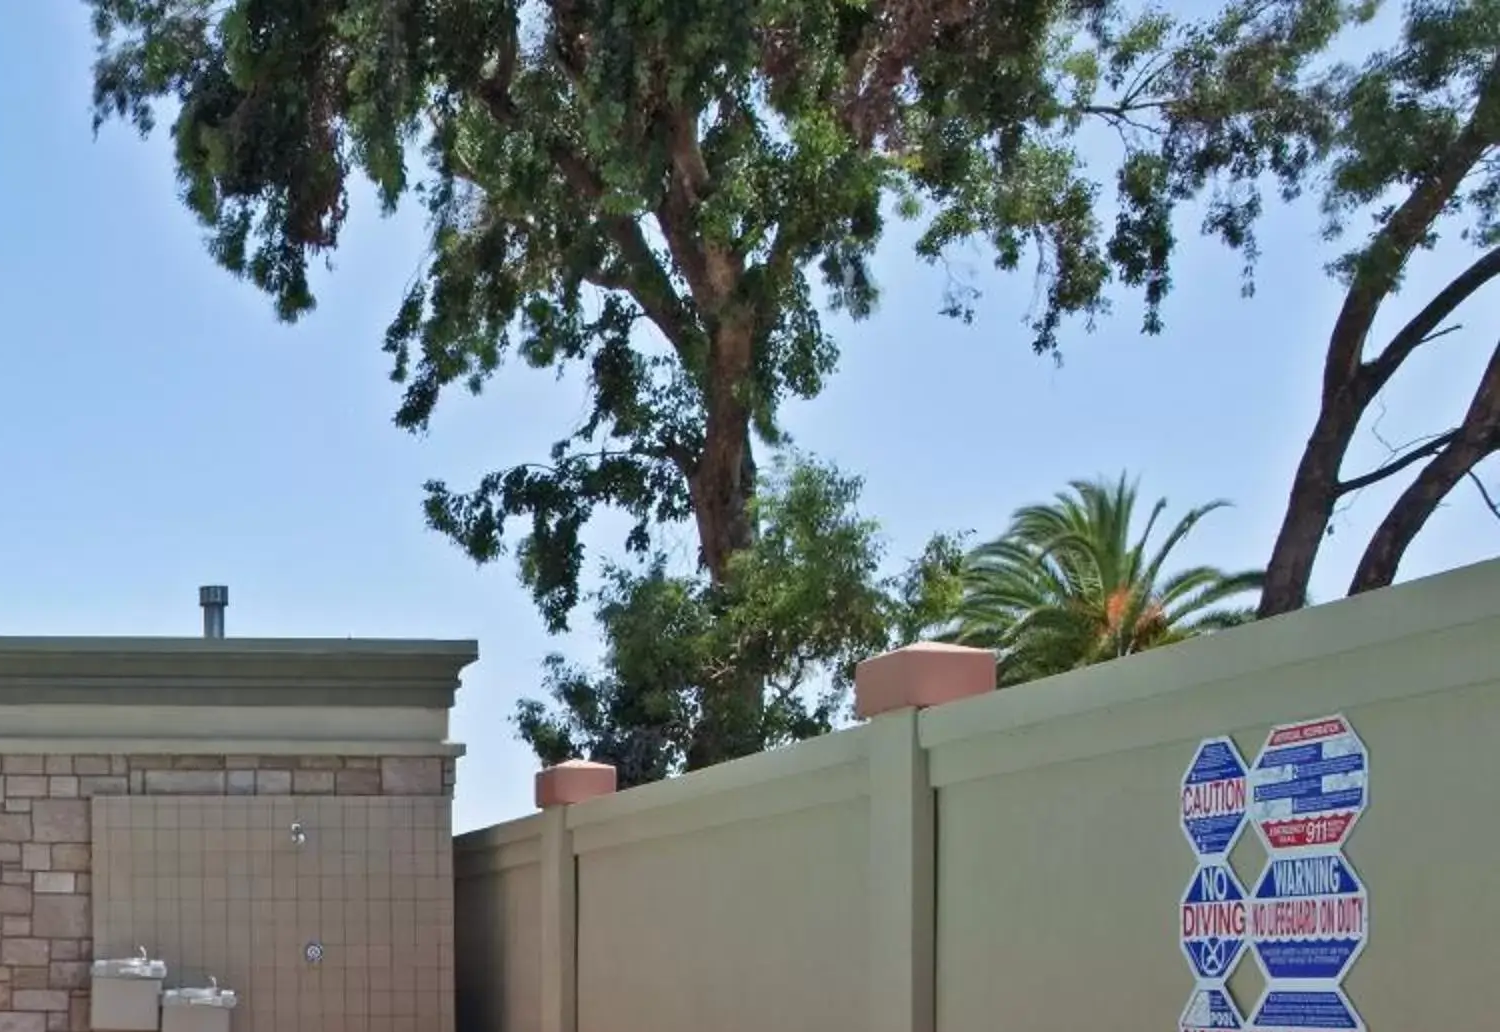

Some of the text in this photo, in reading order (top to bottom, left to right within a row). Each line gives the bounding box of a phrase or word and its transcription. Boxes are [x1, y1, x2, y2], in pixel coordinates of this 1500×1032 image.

[1183, 780, 1245, 815] CAUTION
[1306, 820, 1327, 843] 911
[1201, 868, 1227, 901] NO
[1273, 858, 1339, 896] WARNING
[1183, 903, 1246, 936] DIVING
[1253, 897, 1365, 936] NO LIFEGUARD ON DUTY
